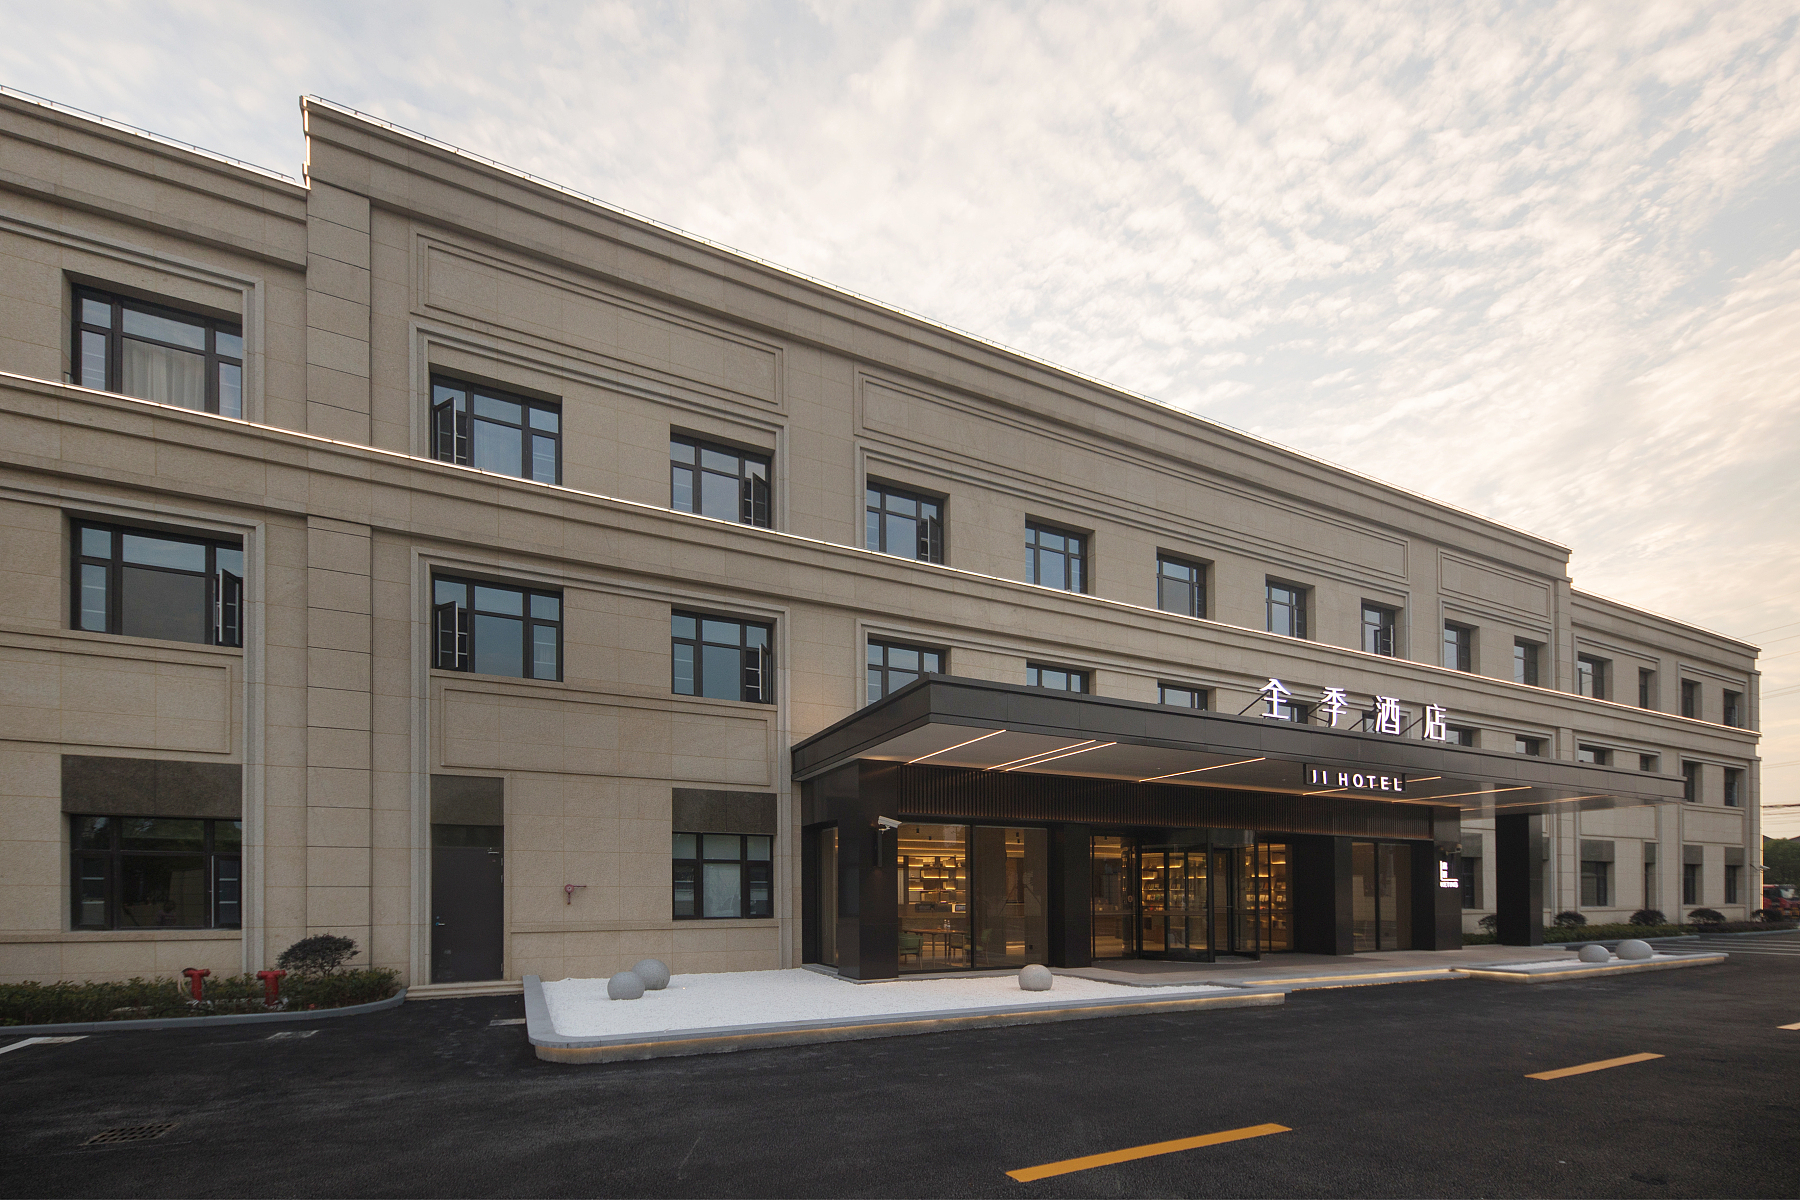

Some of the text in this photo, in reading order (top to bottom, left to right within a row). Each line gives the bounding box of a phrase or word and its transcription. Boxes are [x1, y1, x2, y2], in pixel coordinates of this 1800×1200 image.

[1259, 678, 1446, 741] 全季酒店
[1338, 772, 1402, 792] HOTEL
